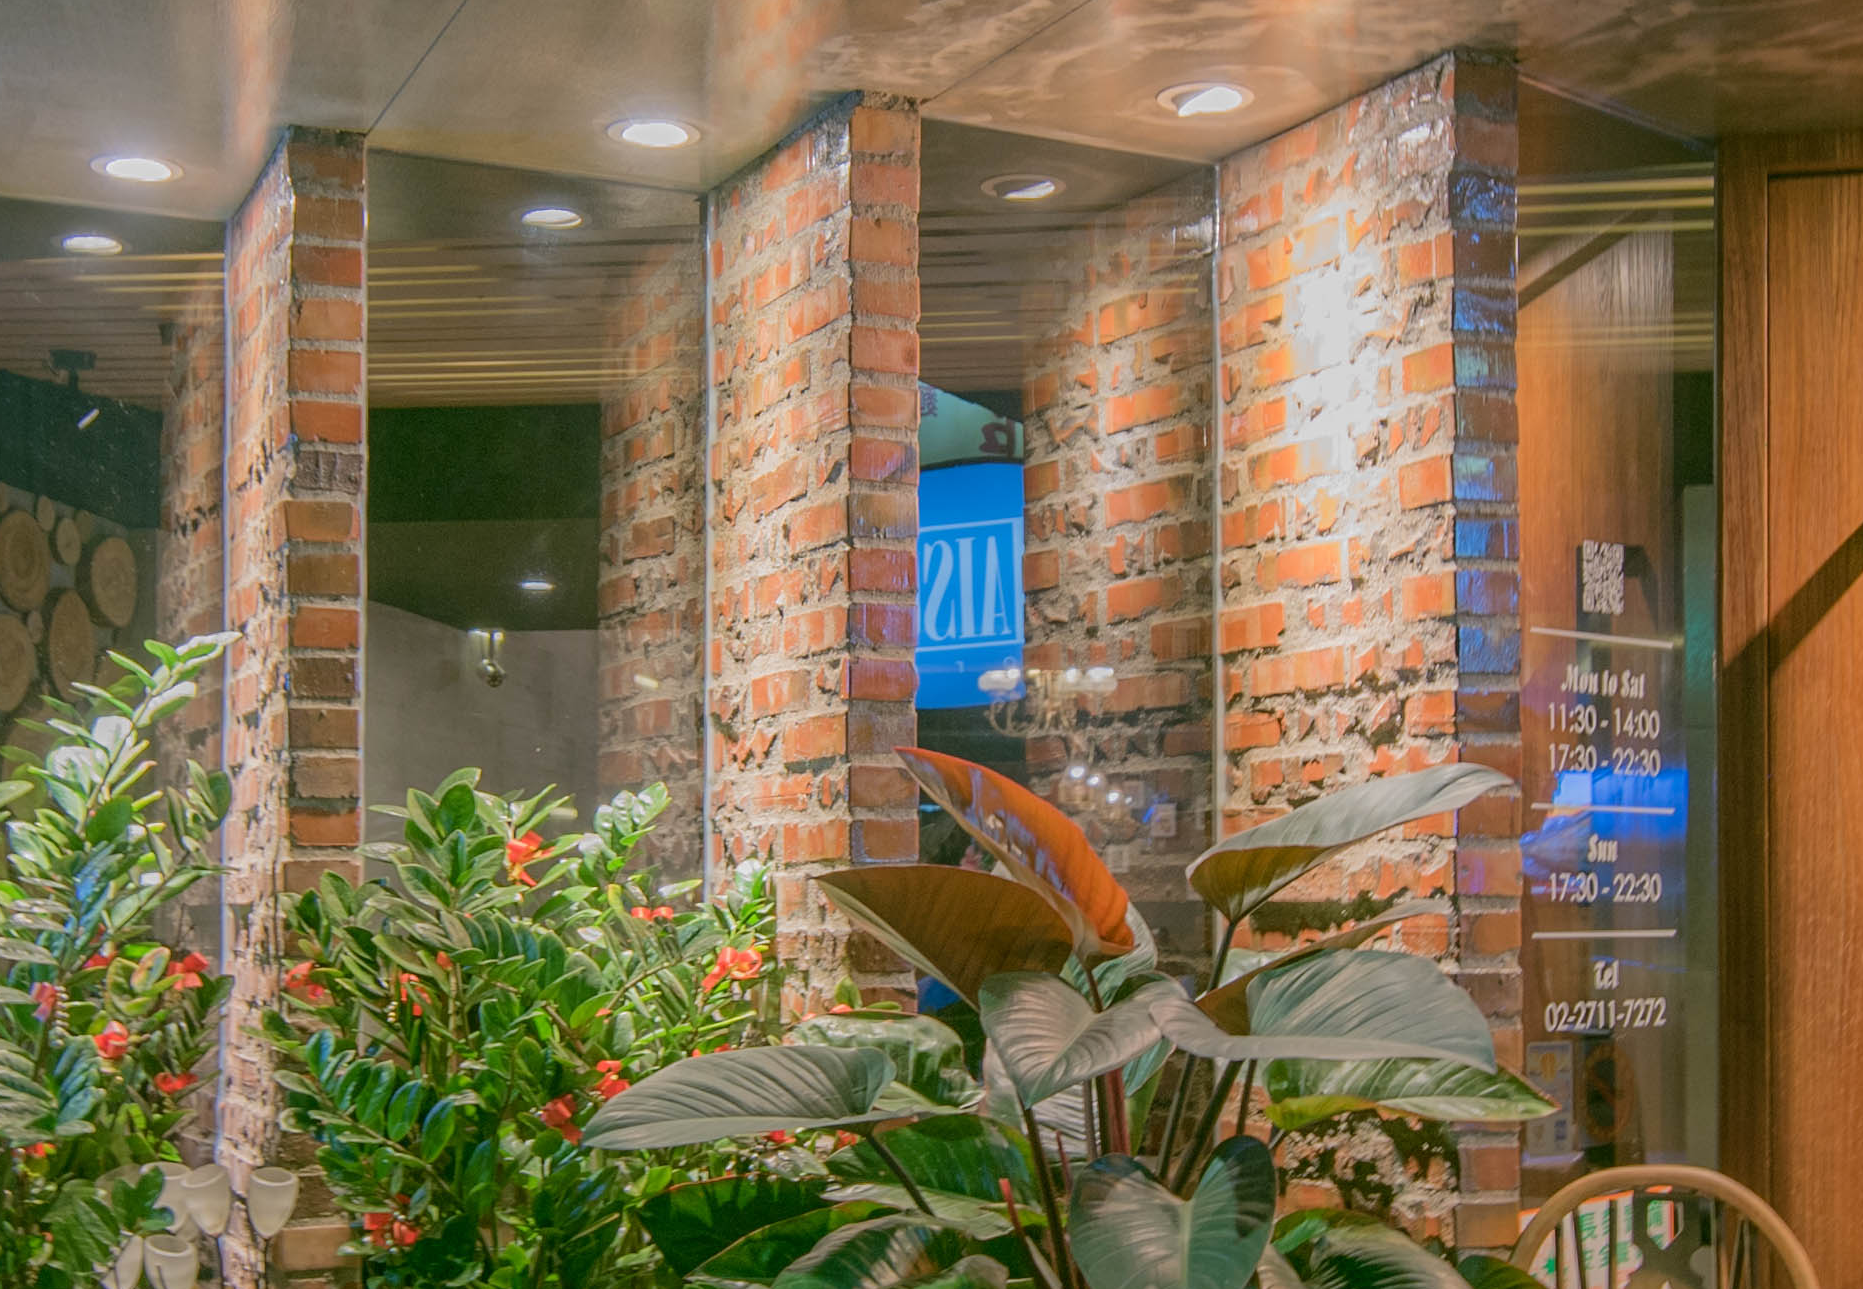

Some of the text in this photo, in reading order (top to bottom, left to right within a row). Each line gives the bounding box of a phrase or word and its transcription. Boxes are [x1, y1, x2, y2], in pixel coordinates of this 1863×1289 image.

[1561, 663, 1646, 700] Mon to Sat
[1548, 701, 1598, 736] 11:30
[1613, 707, 1661, 741] 14:00
[1548, 742, 1598, 773] 17:30
[1612, 746, 1662, 779] 22:30
[1586, 833, 1619, 863] Sun
[1548, 872, 1599, 903] 17:30
[1612, 873, 1663, 903] 22:30
[1593, 958, 1621, 991] Tel
[1544, 996, 1668, 1032] 02-2711-7272
